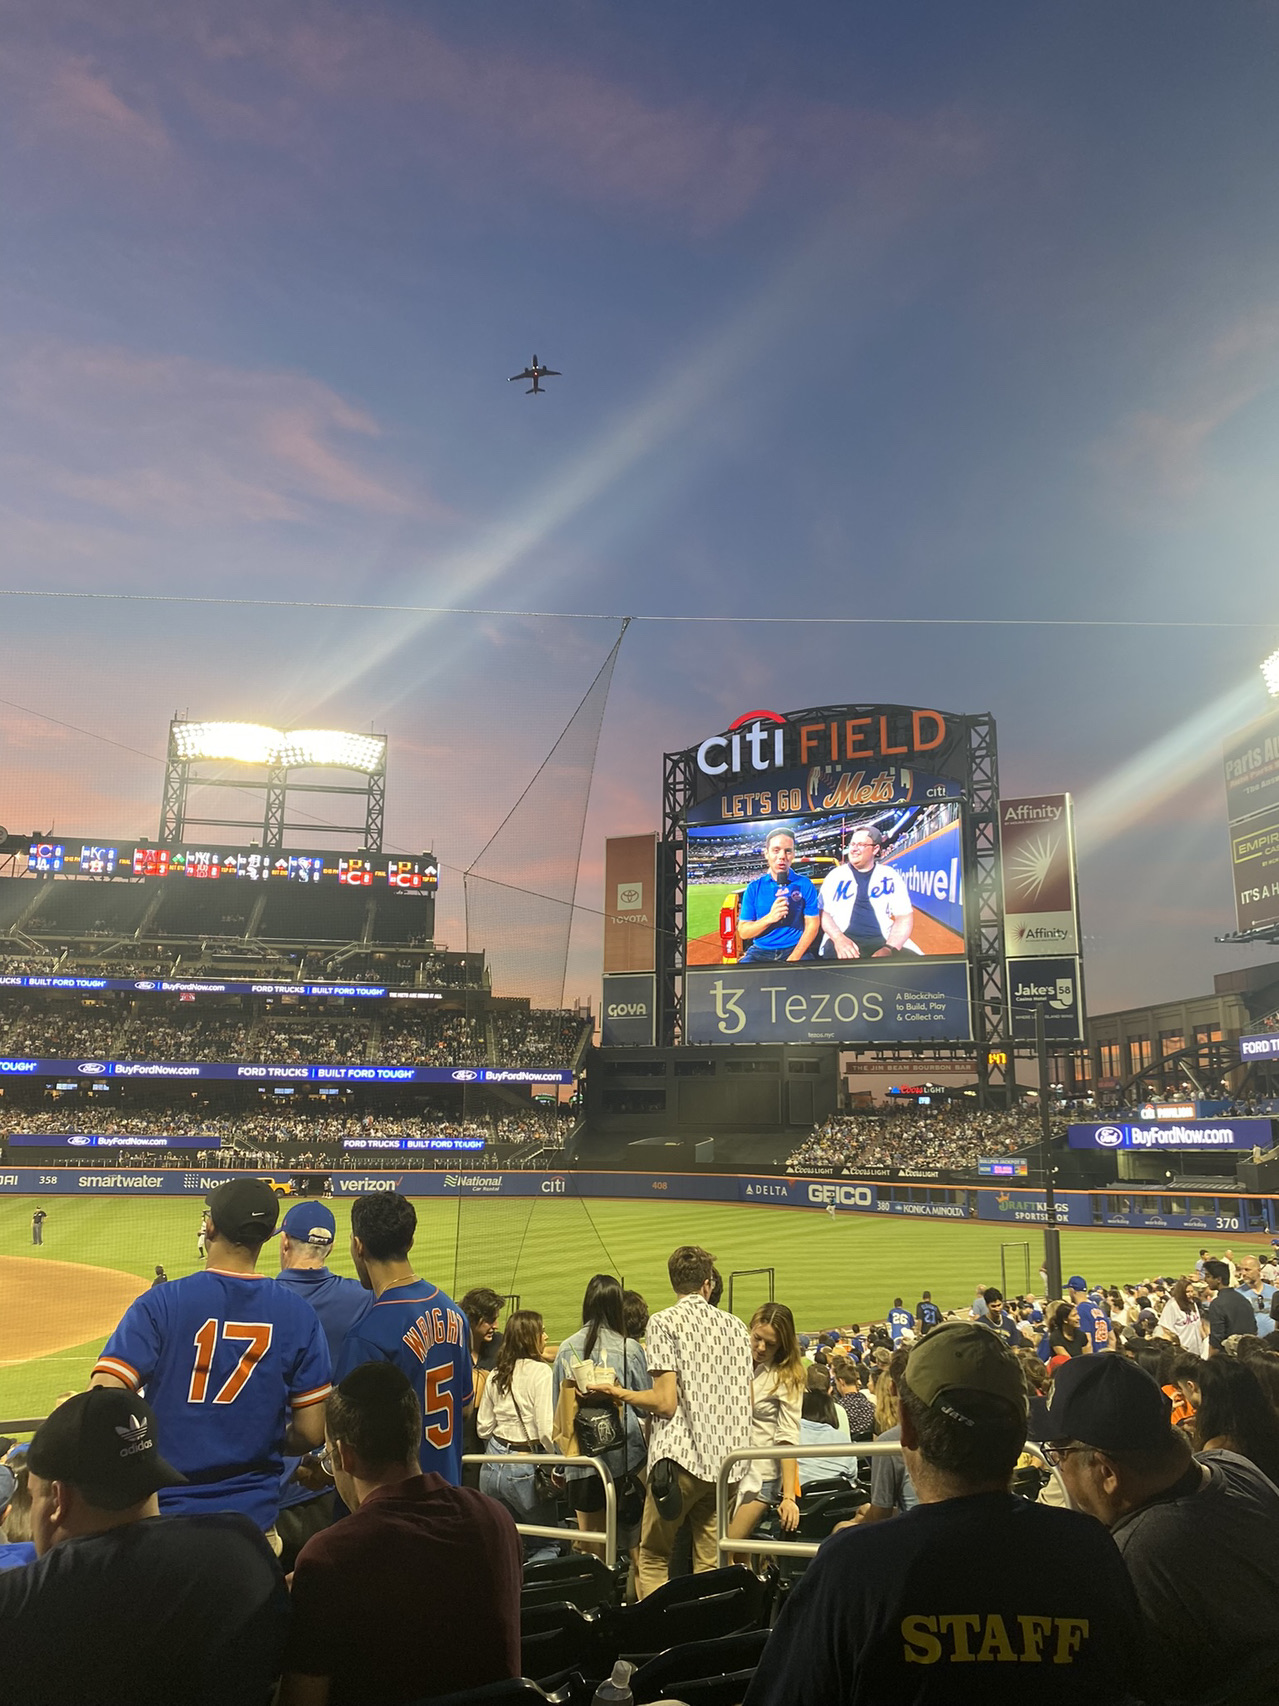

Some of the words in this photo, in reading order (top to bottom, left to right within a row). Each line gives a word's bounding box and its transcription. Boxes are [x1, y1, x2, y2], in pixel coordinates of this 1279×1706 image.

[697, 720, 784, 776] citi
[800, 709, 946, 765] FIELD
[1225, 747, 1262, 781] Parts
[721, 791, 773, 819] LET'S
[777, 788, 802, 812] GO
[822, 770, 896, 810] Mets
[926, 786, 947, 798] citi
[1004, 803, 1063, 821] Affinity
[1241, 887, 1261, 905] IT'S
[1262, 885, 1271, 899] A
[610, 914, 648, 925] TOYOTA
[1025, 927, 1069, 941] Affinity
[29, 978, 52, 986] BUILT
[52, 978, 75, 986] FORD
[161, 982, 226, 992] BuyFordNow.com
[252, 985, 274, 993] FORD
[274, 986, 306, 994] TRUCKS
[1014, 982, 1056, 996] Jake's
[1058, 986, 1071, 994] 58
[895, 992, 903, 1001] A
[904, 991, 946, 1001] Blockchain
[607, 1003, 648, 1017] GOYA
[759, 986, 884, 1024] Tezos
[896, 1003, 904, 1011] to
[906, 1002, 928, 1012] Build,
[929, 1002, 947, 1012] Play
[896, 1013, 904, 1022] &
[904, 1012, 932, 1022] Collect
[933, 1013, 946, 1021] on.
[1242, 1040, 1270, 1054] FORD
[114, 1064, 200, 1076] BuyFordNow.com
[237, 1066, 266, 1077] FORD
[268, 1067, 308, 1078] TRUCKS
[318, 1068, 346, 1078] BUILT
[347, 1069, 376, 1079] FORD
[376, 1070, 412, 1079] TOUGH
[485, 1071, 562, 1082] BuyFordNow.com
[98, 1137, 168, 1146] BuyFordNow.com
[1131, 1126, 1234, 1147] BuyFordNow.com
[344, 1140, 367, 1148] FORD
[368, 1140, 400, 1148] TRUCKS
[38, 1176, 58, 1185] 358
[78, 1174, 164, 1188] smartwater
[340, 1178, 397, 1192] verizon
[457, 1176, 502, 1186] National
[541, 1178, 566, 1193] citi
[651, 1182, 668, 1190] 408
[755, 1184, 788, 1196] DELTA
[808, 1184, 872, 1207] GEICO
[876, 1201, 890, 1212] 380
[903, 1204, 932, 1216] KONICA
[932, 1206, 965, 1217] MINOLTA
[1216, 1217, 1240, 1230] 370
[892, 1312, 908, 1325] 26
[924, 1310, 936, 1325] 21
[402, 1307, 464, 1364] WRIGHT
[187, 1317, 274, 1405] 17
[424, 1360, 455, 1451] 5
[120, 1438, 154, 1458] adidas
[900, 1613, 1090, 1665] STAFF
